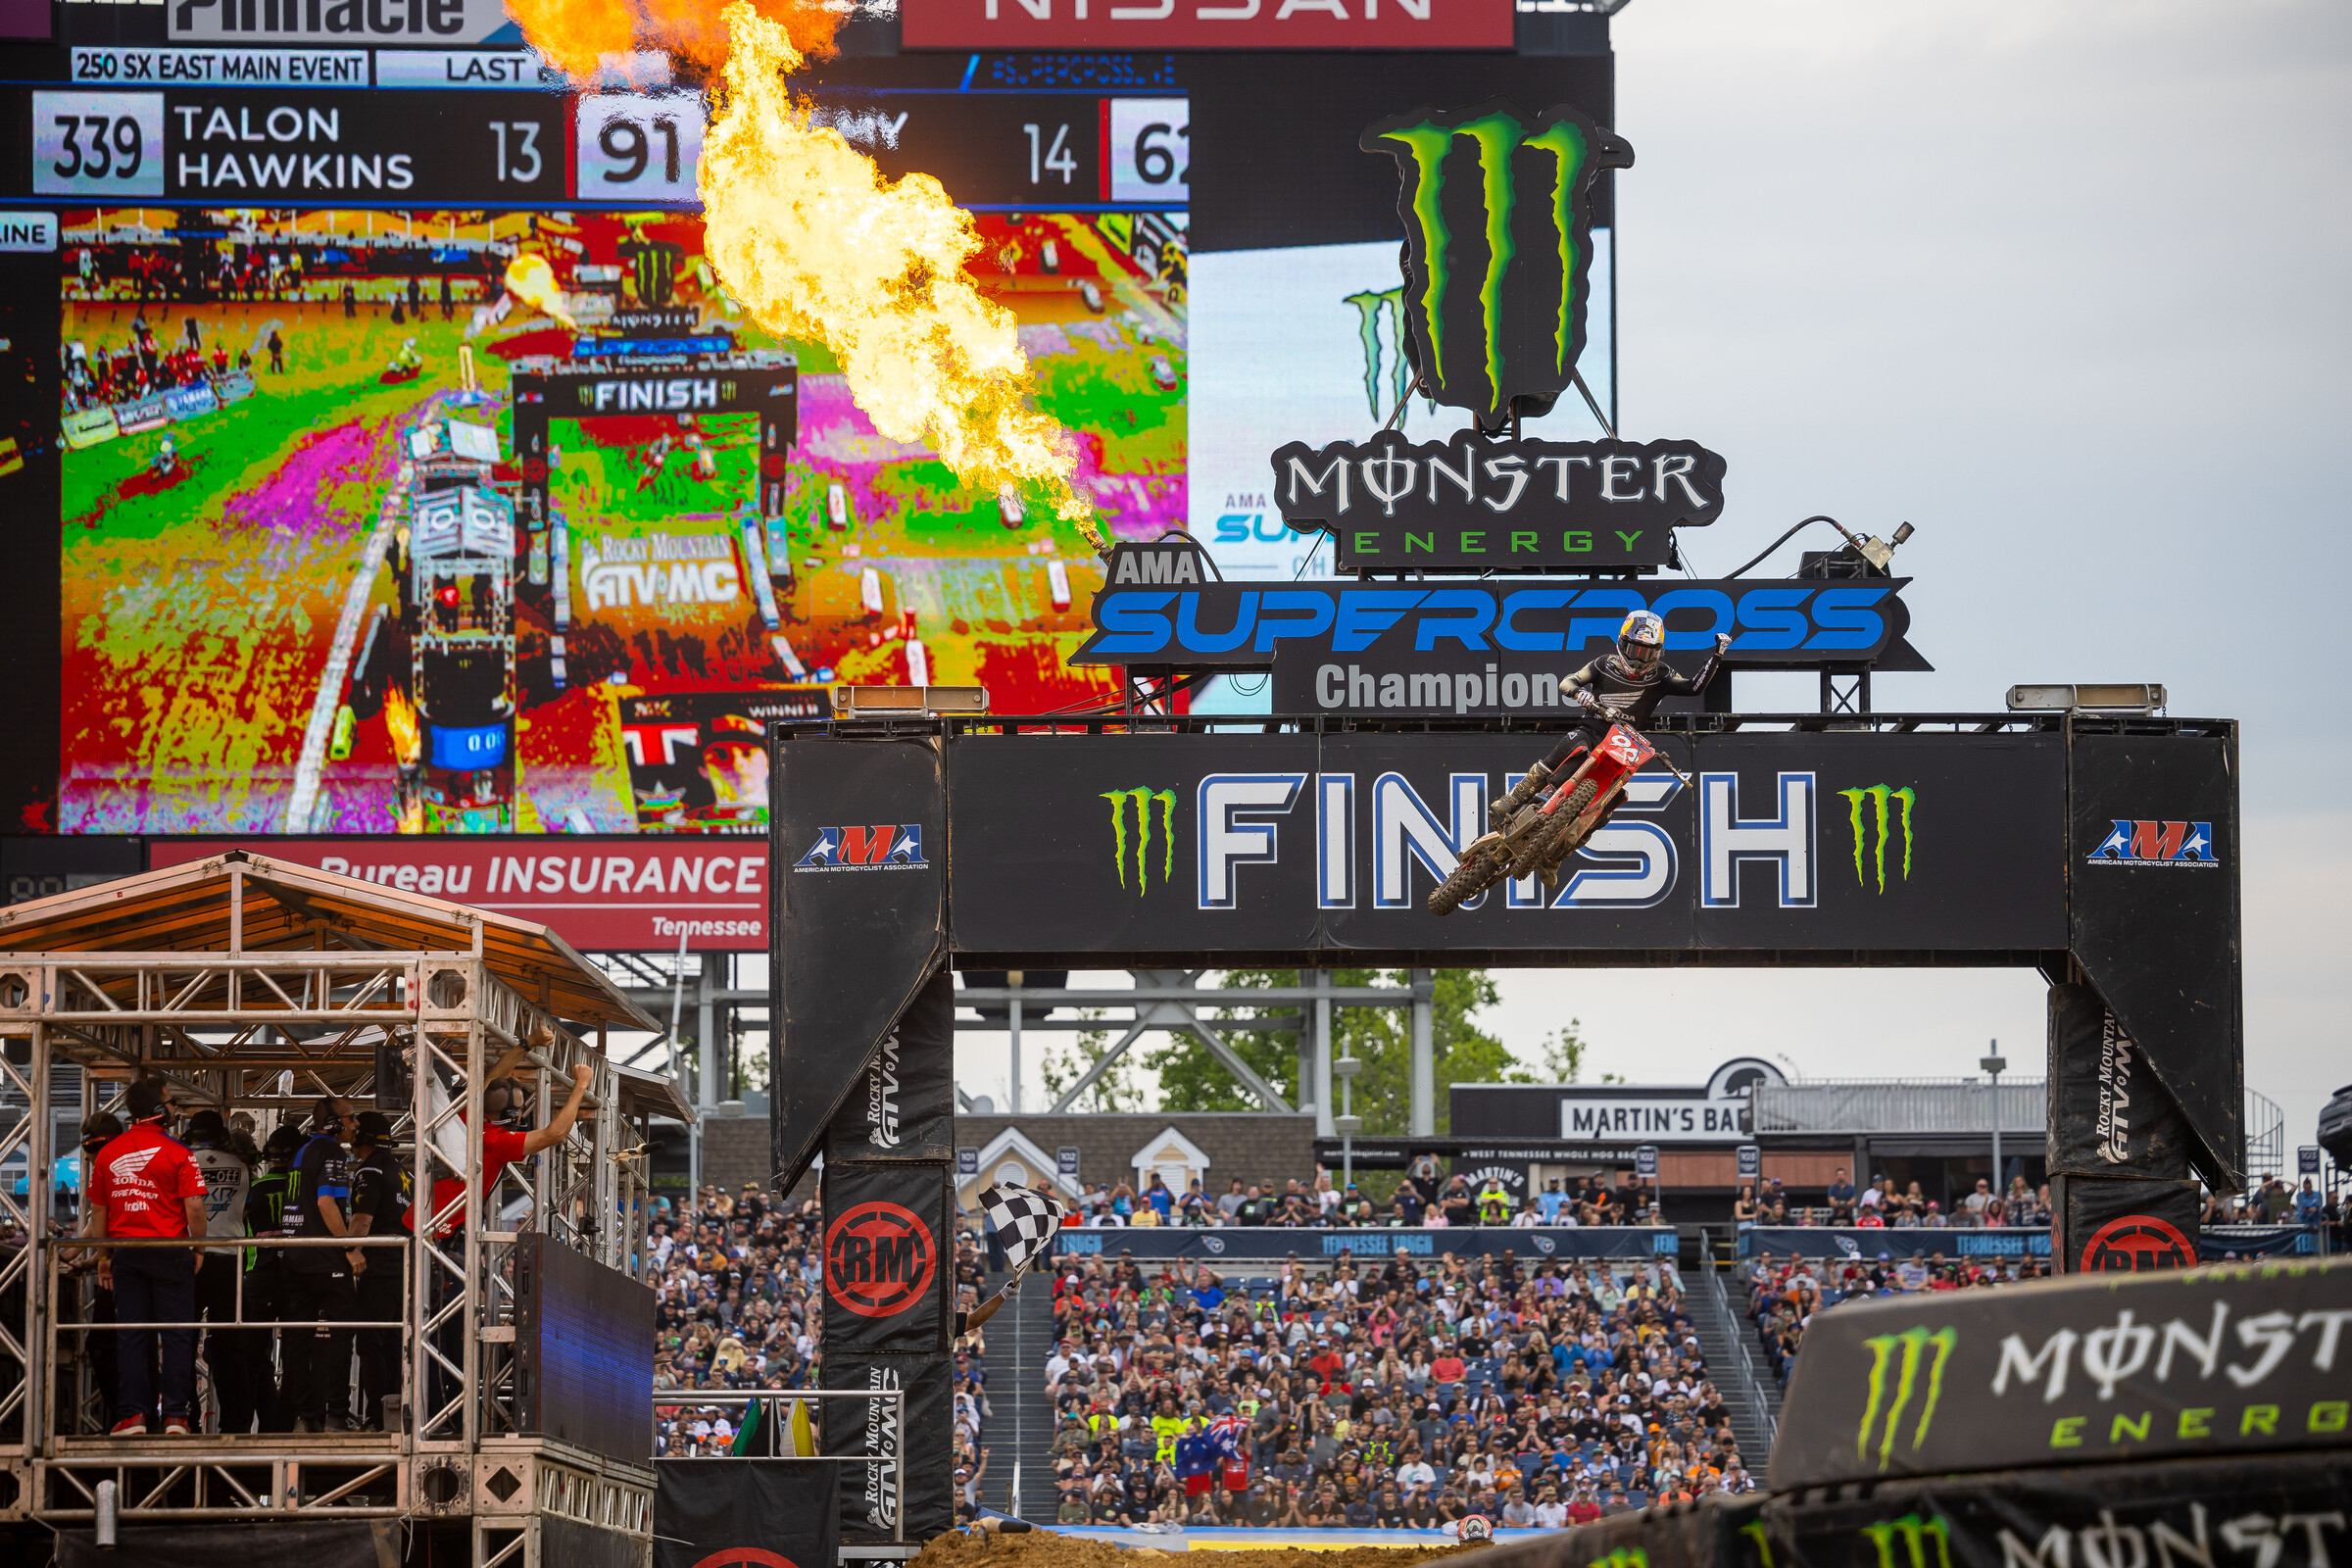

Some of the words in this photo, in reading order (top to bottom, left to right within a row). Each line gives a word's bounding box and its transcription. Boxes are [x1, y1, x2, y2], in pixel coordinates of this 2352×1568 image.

[77, 53, 118, 78] 250
[123, 53, 152, 78] SX
[159, 54, 216, 80] EAST
[221, 55, 281, 80] MAIN
[289, 56, 363, 82] EVENT
[447, 58, 526, 82] LAST
[174, 106, 340, 143] TALON
[54, 115, 143, 179] 339
[489, 122, 542, 183] 13
[599, 116, 681, 183] 91
[1023, 122, 1078, 185] 14
[177, 153, 415, 190] HAWKINS
[0, 223, 46, 244] INE
[594, 377, 718, 412] FINISH
[1225, 493, 1267, 509] AMA
[602, 533, 649, 563] ROCKY
[651, 530, 732, 562] MOUNTAIN
[1354, 530, 1644, 554] ENERGY
[1115, 550, 1199, 585] AMA
[1089, 588, 1890, 654] SUPERCROSS
[793, 823, 930, 867] AMA
[1197, 771, 1818, 911] FINISH
[2085, 819, 2220, 861] AMA
[486, 856, 766, 894] INSURANCE
[652, 915, 761, 937] Tennessee
[867, 1072, 881, 1125] ROCKY
[2096, 1085, 2112, 1139] ROCKY
[1573, 1106, 1694, 1132] MARTIN'S
[1469, 1150, 1495, 1159] WEST
[1497, 1150, 1551, 1159] TENNESSEE
[1553, 1150, 1589, 1160] WHOLE
[1591, 1151, 1615, 1160] HOG
[112, 1176, 158, 1189] HONDA
[844, 1235, 913, 1284] RM
[1322, 1234, 1390, 1254] TENNESSEE
[2050, 1399, 2350, 1449] ENERG
